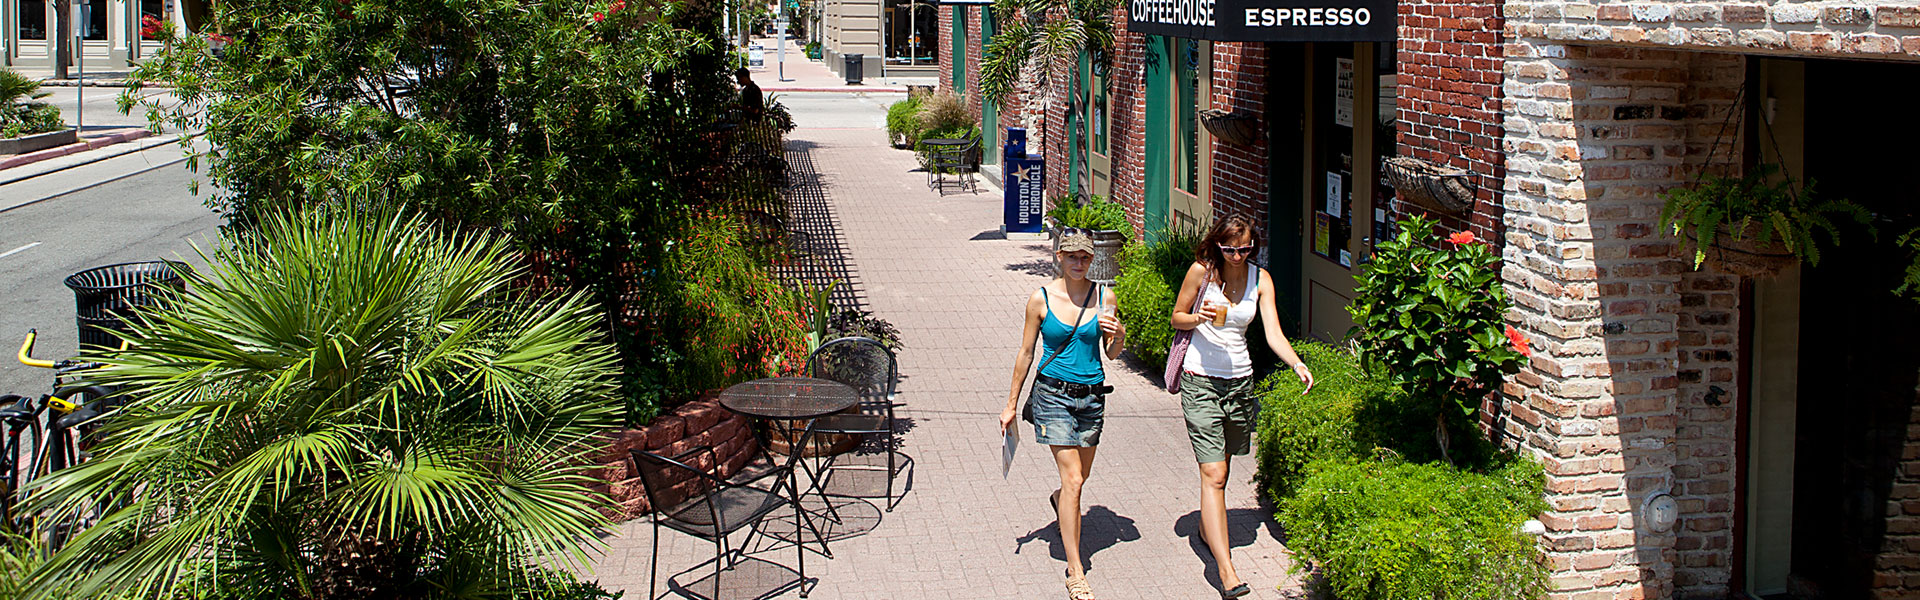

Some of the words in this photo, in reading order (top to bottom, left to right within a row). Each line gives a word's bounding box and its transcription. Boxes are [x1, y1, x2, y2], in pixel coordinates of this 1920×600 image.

[1132, 0, 1216, 27] COFFEEHOUSE
[1245, 9, 1371, 27] ESPRESSO
[1018, 182, 1030, 224] HOUSTON
[1031, 164, 1041, 214] CHRONICLE
